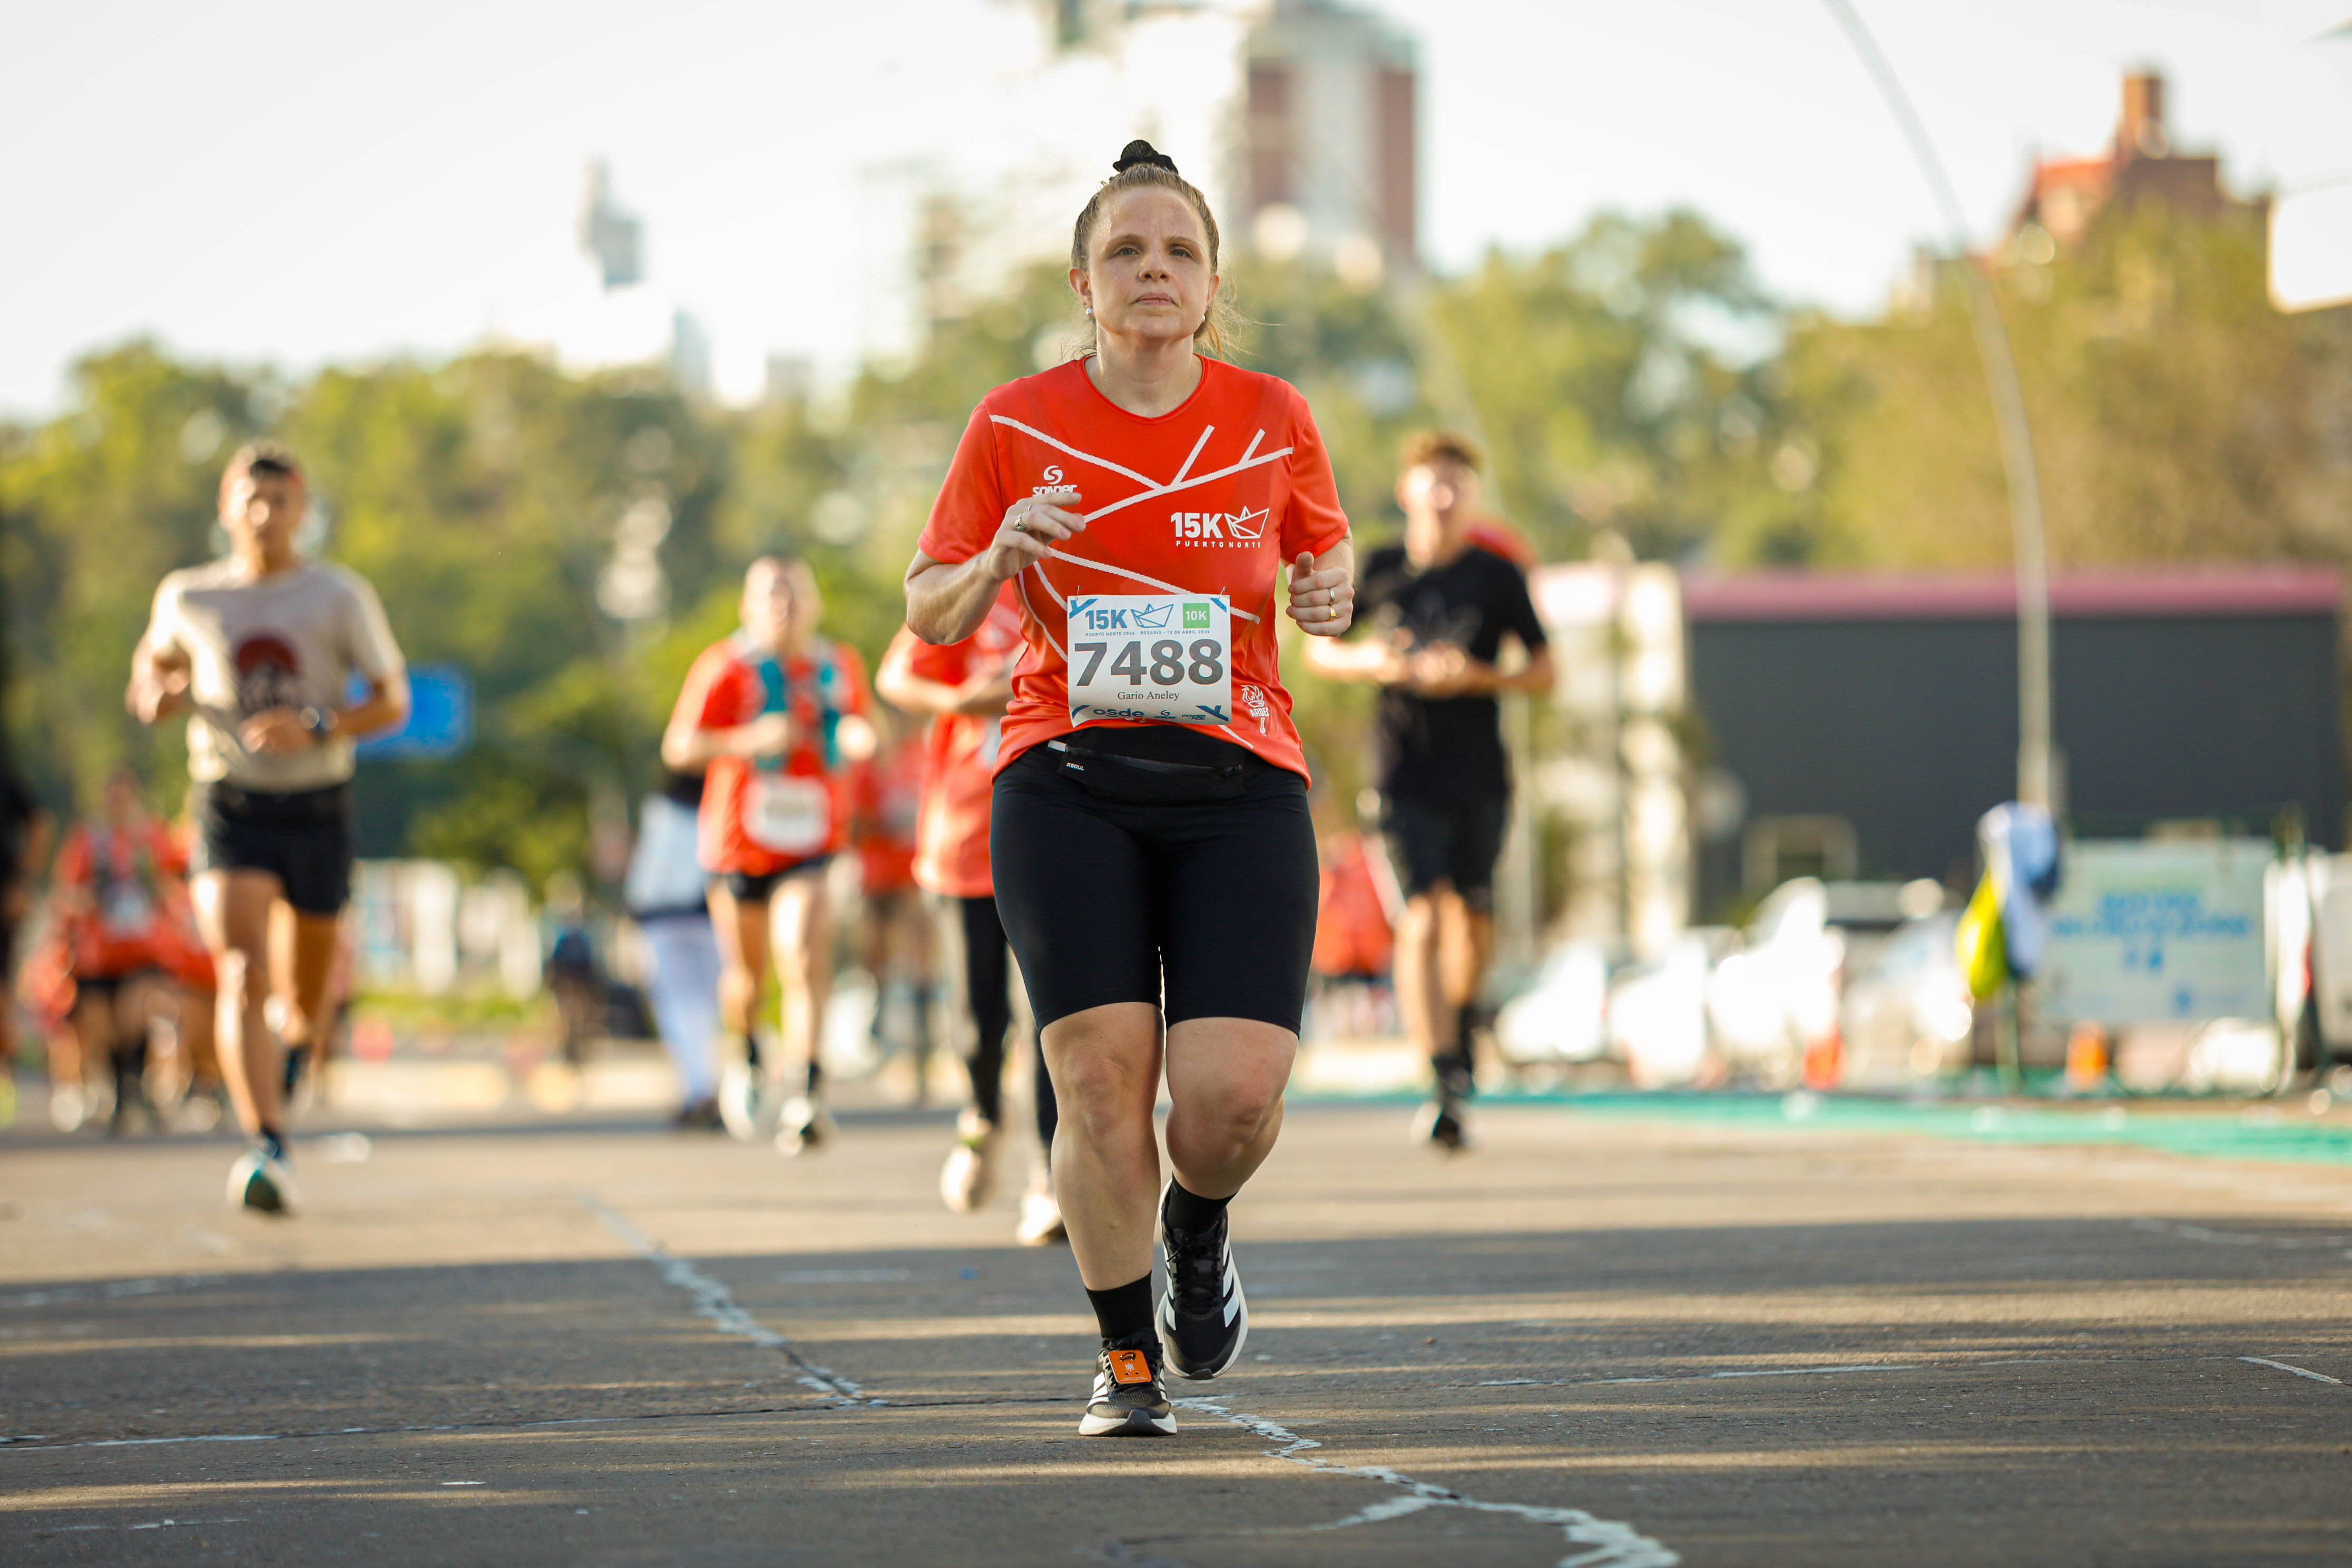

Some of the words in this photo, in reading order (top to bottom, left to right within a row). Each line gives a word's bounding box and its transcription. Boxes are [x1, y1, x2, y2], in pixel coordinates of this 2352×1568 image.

[1171, 512, 1223, 538] 15K
[1085, 609, 1128, 630] 15K
[1185, 611, 1207, 621] 10K
[1074, 639, 1223, 687] 7488
[1118, 691, 1143, 700] Gario
[1146, 691, 1180, 701] Aneley
[1249, 707, 1269, 717] ARDE
